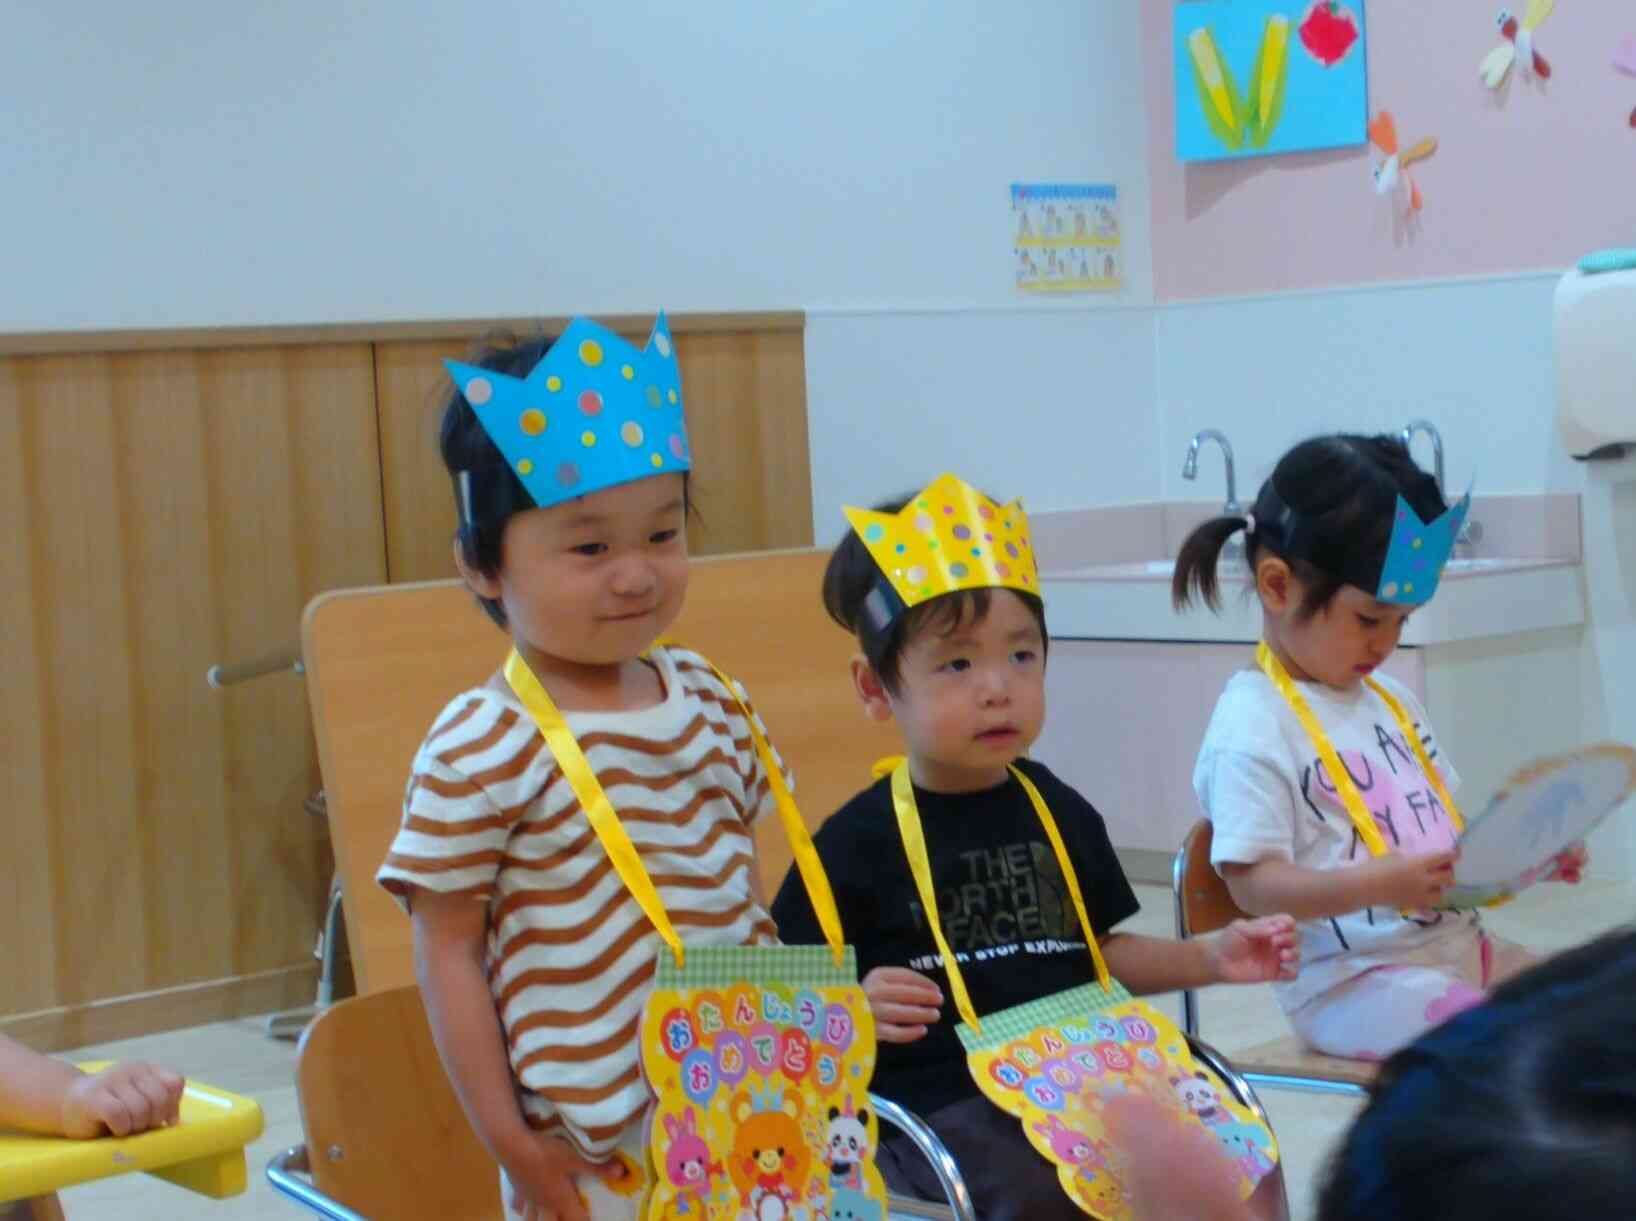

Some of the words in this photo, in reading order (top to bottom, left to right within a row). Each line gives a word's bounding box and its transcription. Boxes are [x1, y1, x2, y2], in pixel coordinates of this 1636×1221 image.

[1300, 751, 1374, 822] YOU
[959, 843, 1031, 881] THE
[945, 906, 1040, 950] FACE
[909, 951, 970, 971] NEVR
[974, 943, 1020, 961] STOP
[666, 991, 849, 1050] おたんじょうび
[687, 1036, 837, 1093] おめでとう
